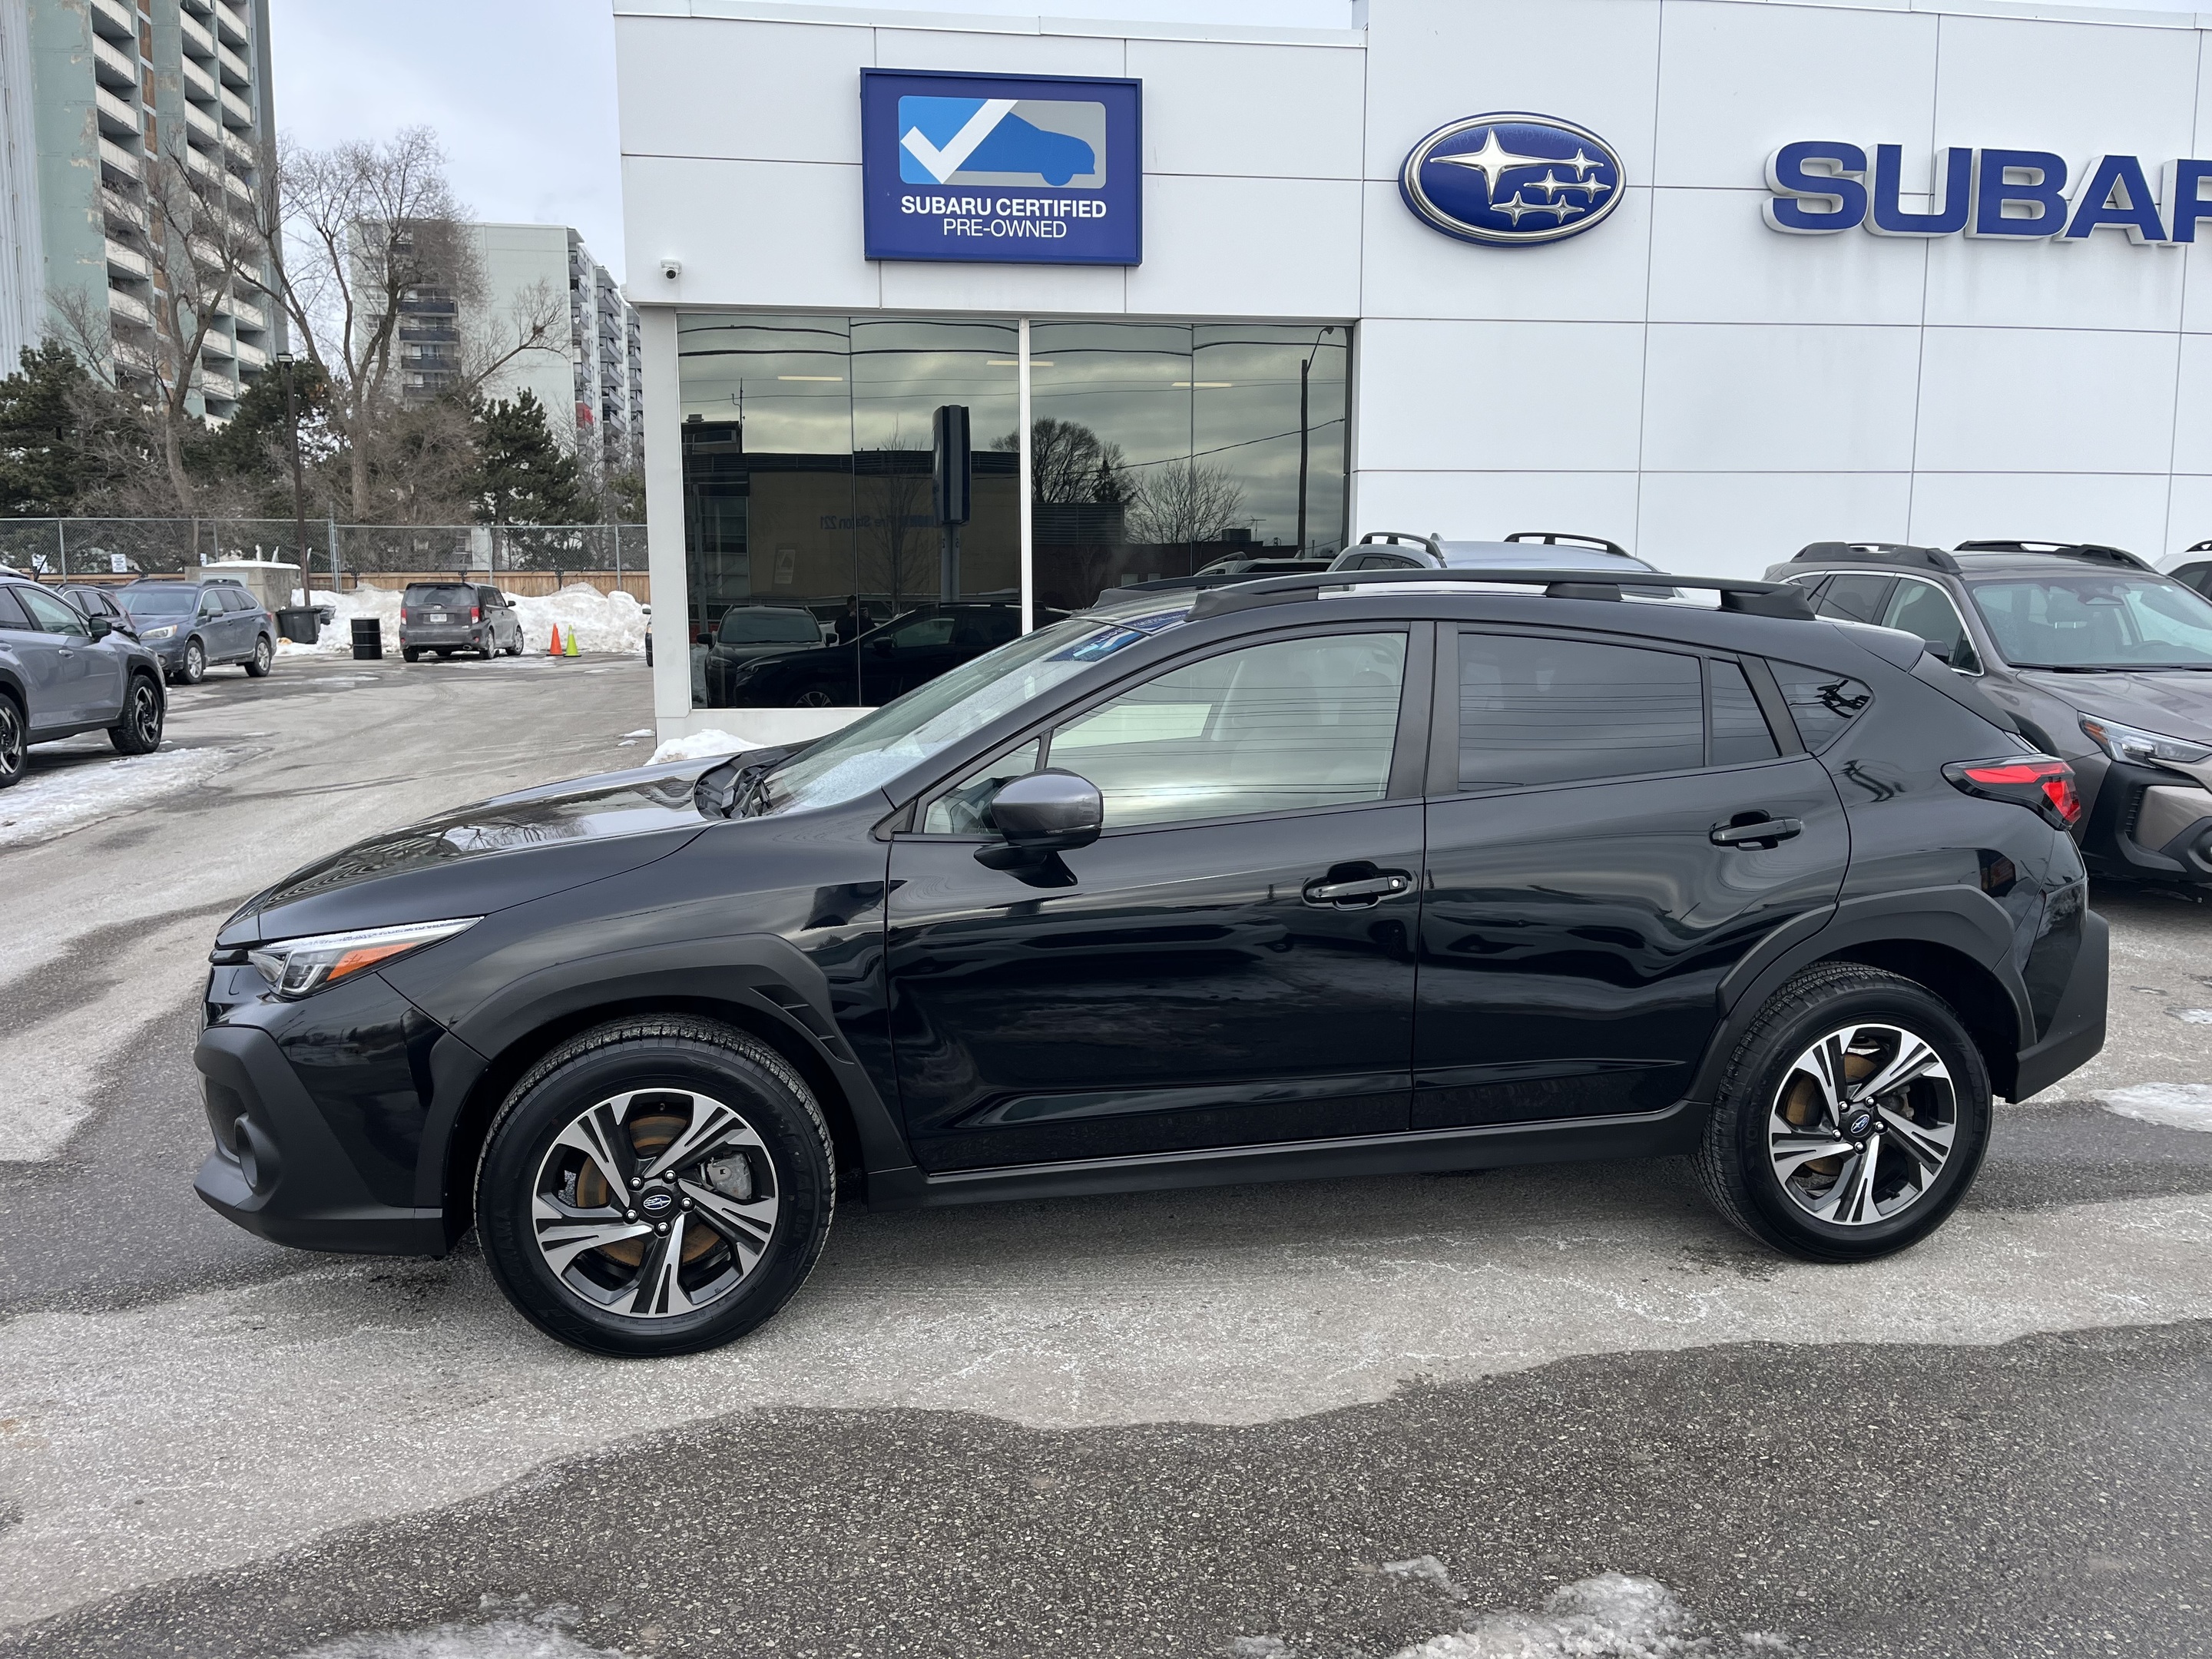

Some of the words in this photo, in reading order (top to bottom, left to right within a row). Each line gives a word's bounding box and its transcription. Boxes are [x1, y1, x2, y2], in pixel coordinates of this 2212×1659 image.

[901, 195, 992, 216] SUBARU
[995, 198, 1107, 218] CERTIFIED
[943, 218, 1067, 238] PRE-OWNED
